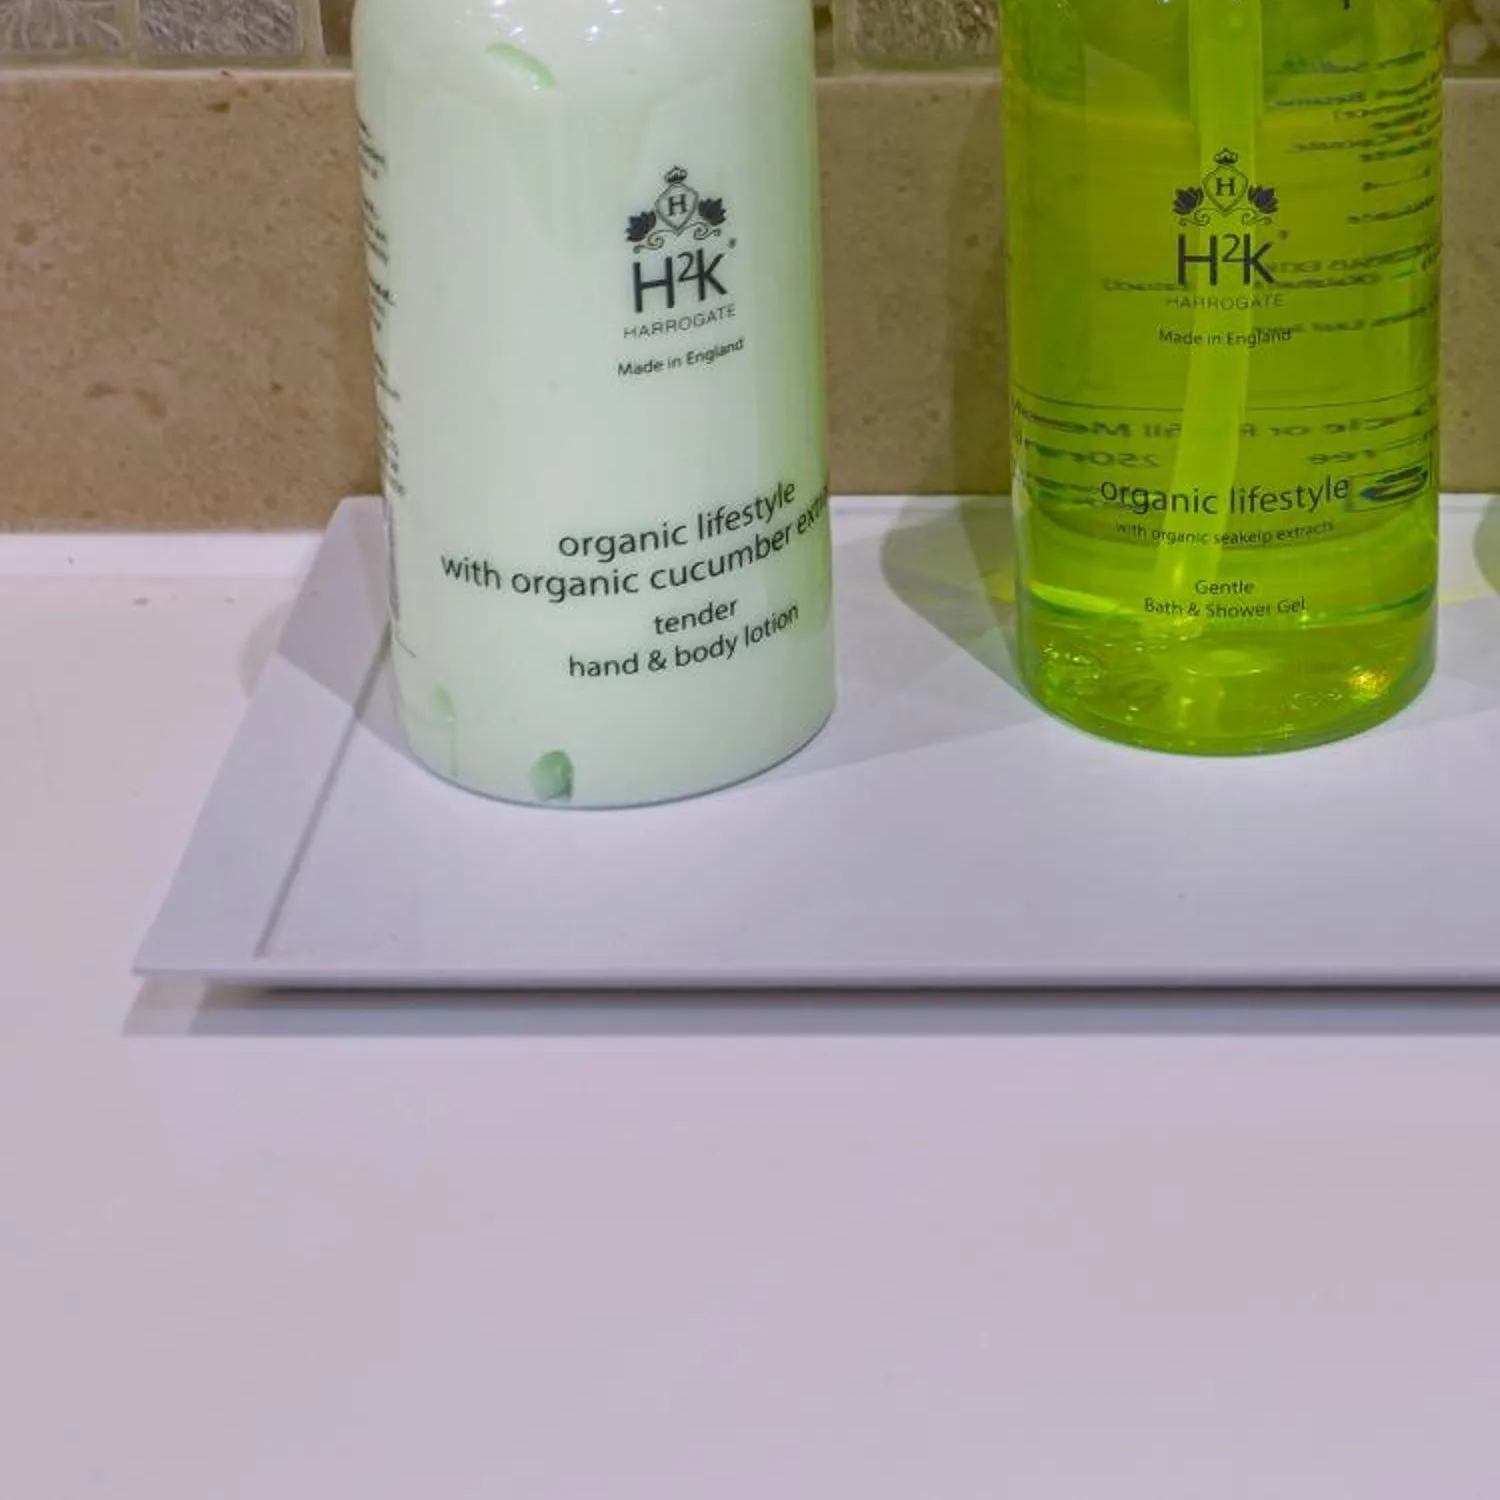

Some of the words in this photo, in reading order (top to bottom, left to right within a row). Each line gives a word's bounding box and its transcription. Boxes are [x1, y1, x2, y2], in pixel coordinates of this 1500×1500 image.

[1215, 177, 1236, 197] H
[667, 193, 689, 216] H
[1167, 293, 1285, 312] HARROGATE
[623, 303, 737, 339] HARROGATE
[1159, 328, 1203, 346] Made
[1207, 330, 1221, 346] in
[1227, 328, 1293, 349] England
[617, 356, 665, 377] Made
[667, 355, 683, 370] in
[686, 338, 746, 365] England
[1101, 480, 1218, 515] organic
[1230, 476, 1351, 515] lifestyle
[558, 520, 690, 563] organic
[698, 481, 796, 542] lifestyle
[1116, 522, 1147, 538] with
[1152, 529, 1209, 545] organic
[1276, 519, 1335, 541] extracts
[440, 554, 502, 590] with
[511, 569, 640, 603] organic
[650, 524, 792, 590] cucumber
[1195, 579, 1256, 596] Gentle
[654, 597, 739, 635] tender
[1143, 597, 1184, 617] Bath
[1187, 602, 1202, 617] &
[1205, 602, 1272, 619] Shower
[1277, 596, 1306, 615] Gel
[568, 651, 640, 678] hand
[648, 649, 668, 673] &
[675, 633, 740, 669] body
[744, 603, 800, 649] lotion
